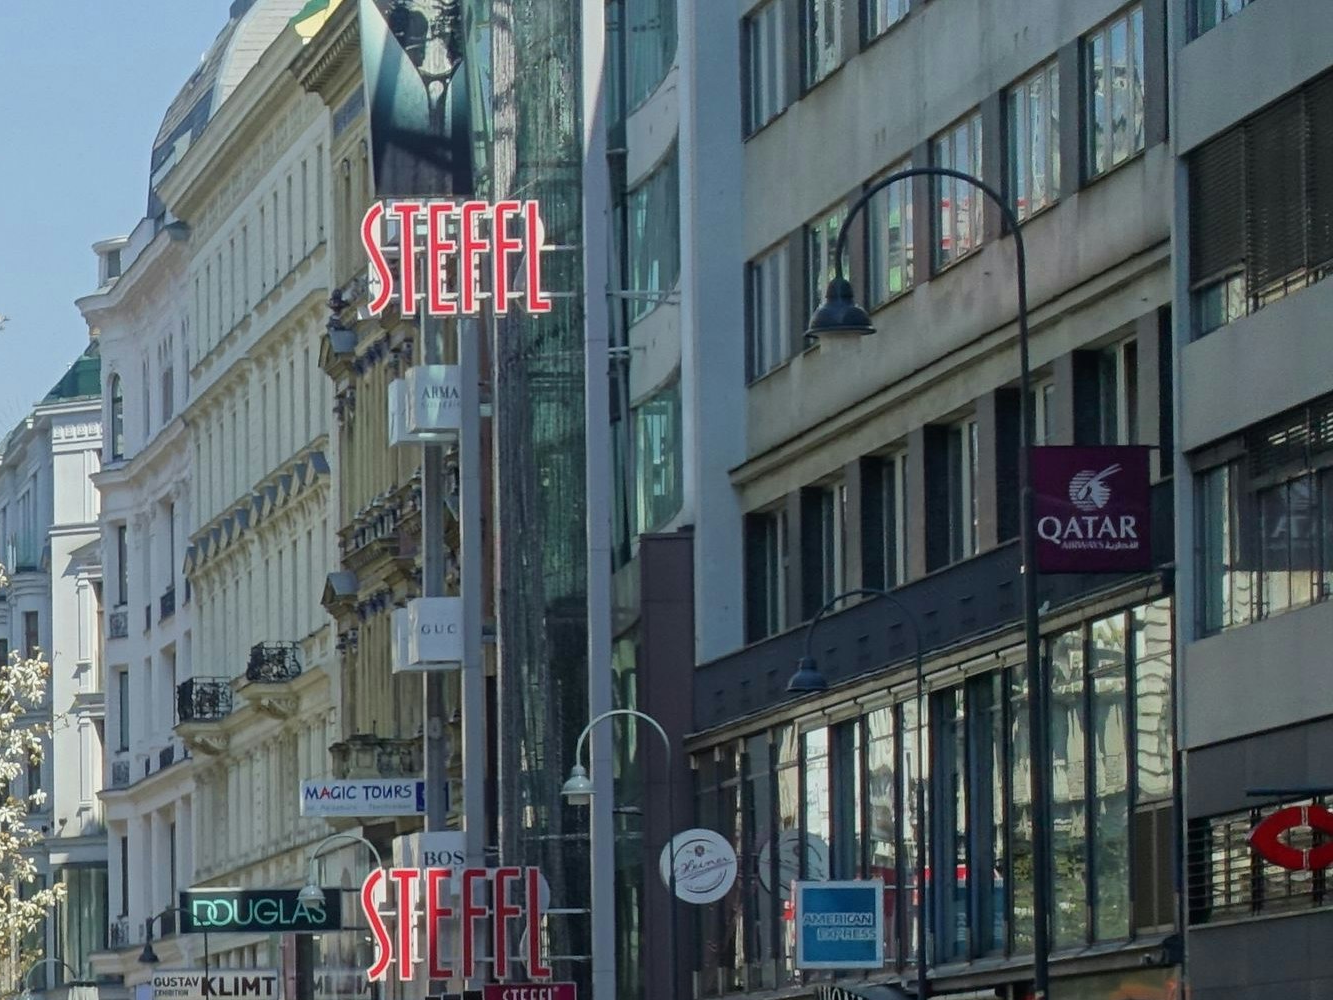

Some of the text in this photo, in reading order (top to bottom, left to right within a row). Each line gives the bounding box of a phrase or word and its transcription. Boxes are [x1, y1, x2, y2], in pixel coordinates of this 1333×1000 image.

[361, 200, 552, 316] STEFFL
[422, 385, 460, 399] ARMA
[1037, 515, 1137, 544] QATAR
[421, 623, 458, 635] GUC
[305, 784, 412, 800] MAGIC TOURS
[424, 851, 465, 866] BOS
[193, 899, 326, 926] DOUGLAS
[803, 912, 873, 926] AMERICAN
[361, 866, 552, 983] STEFFL
[816, 927, 877, 941] EXPRESS
[153, 976, 277, 996] GUSTAV KLIMT
[154, 989, 189, 997] EXHIBITION
